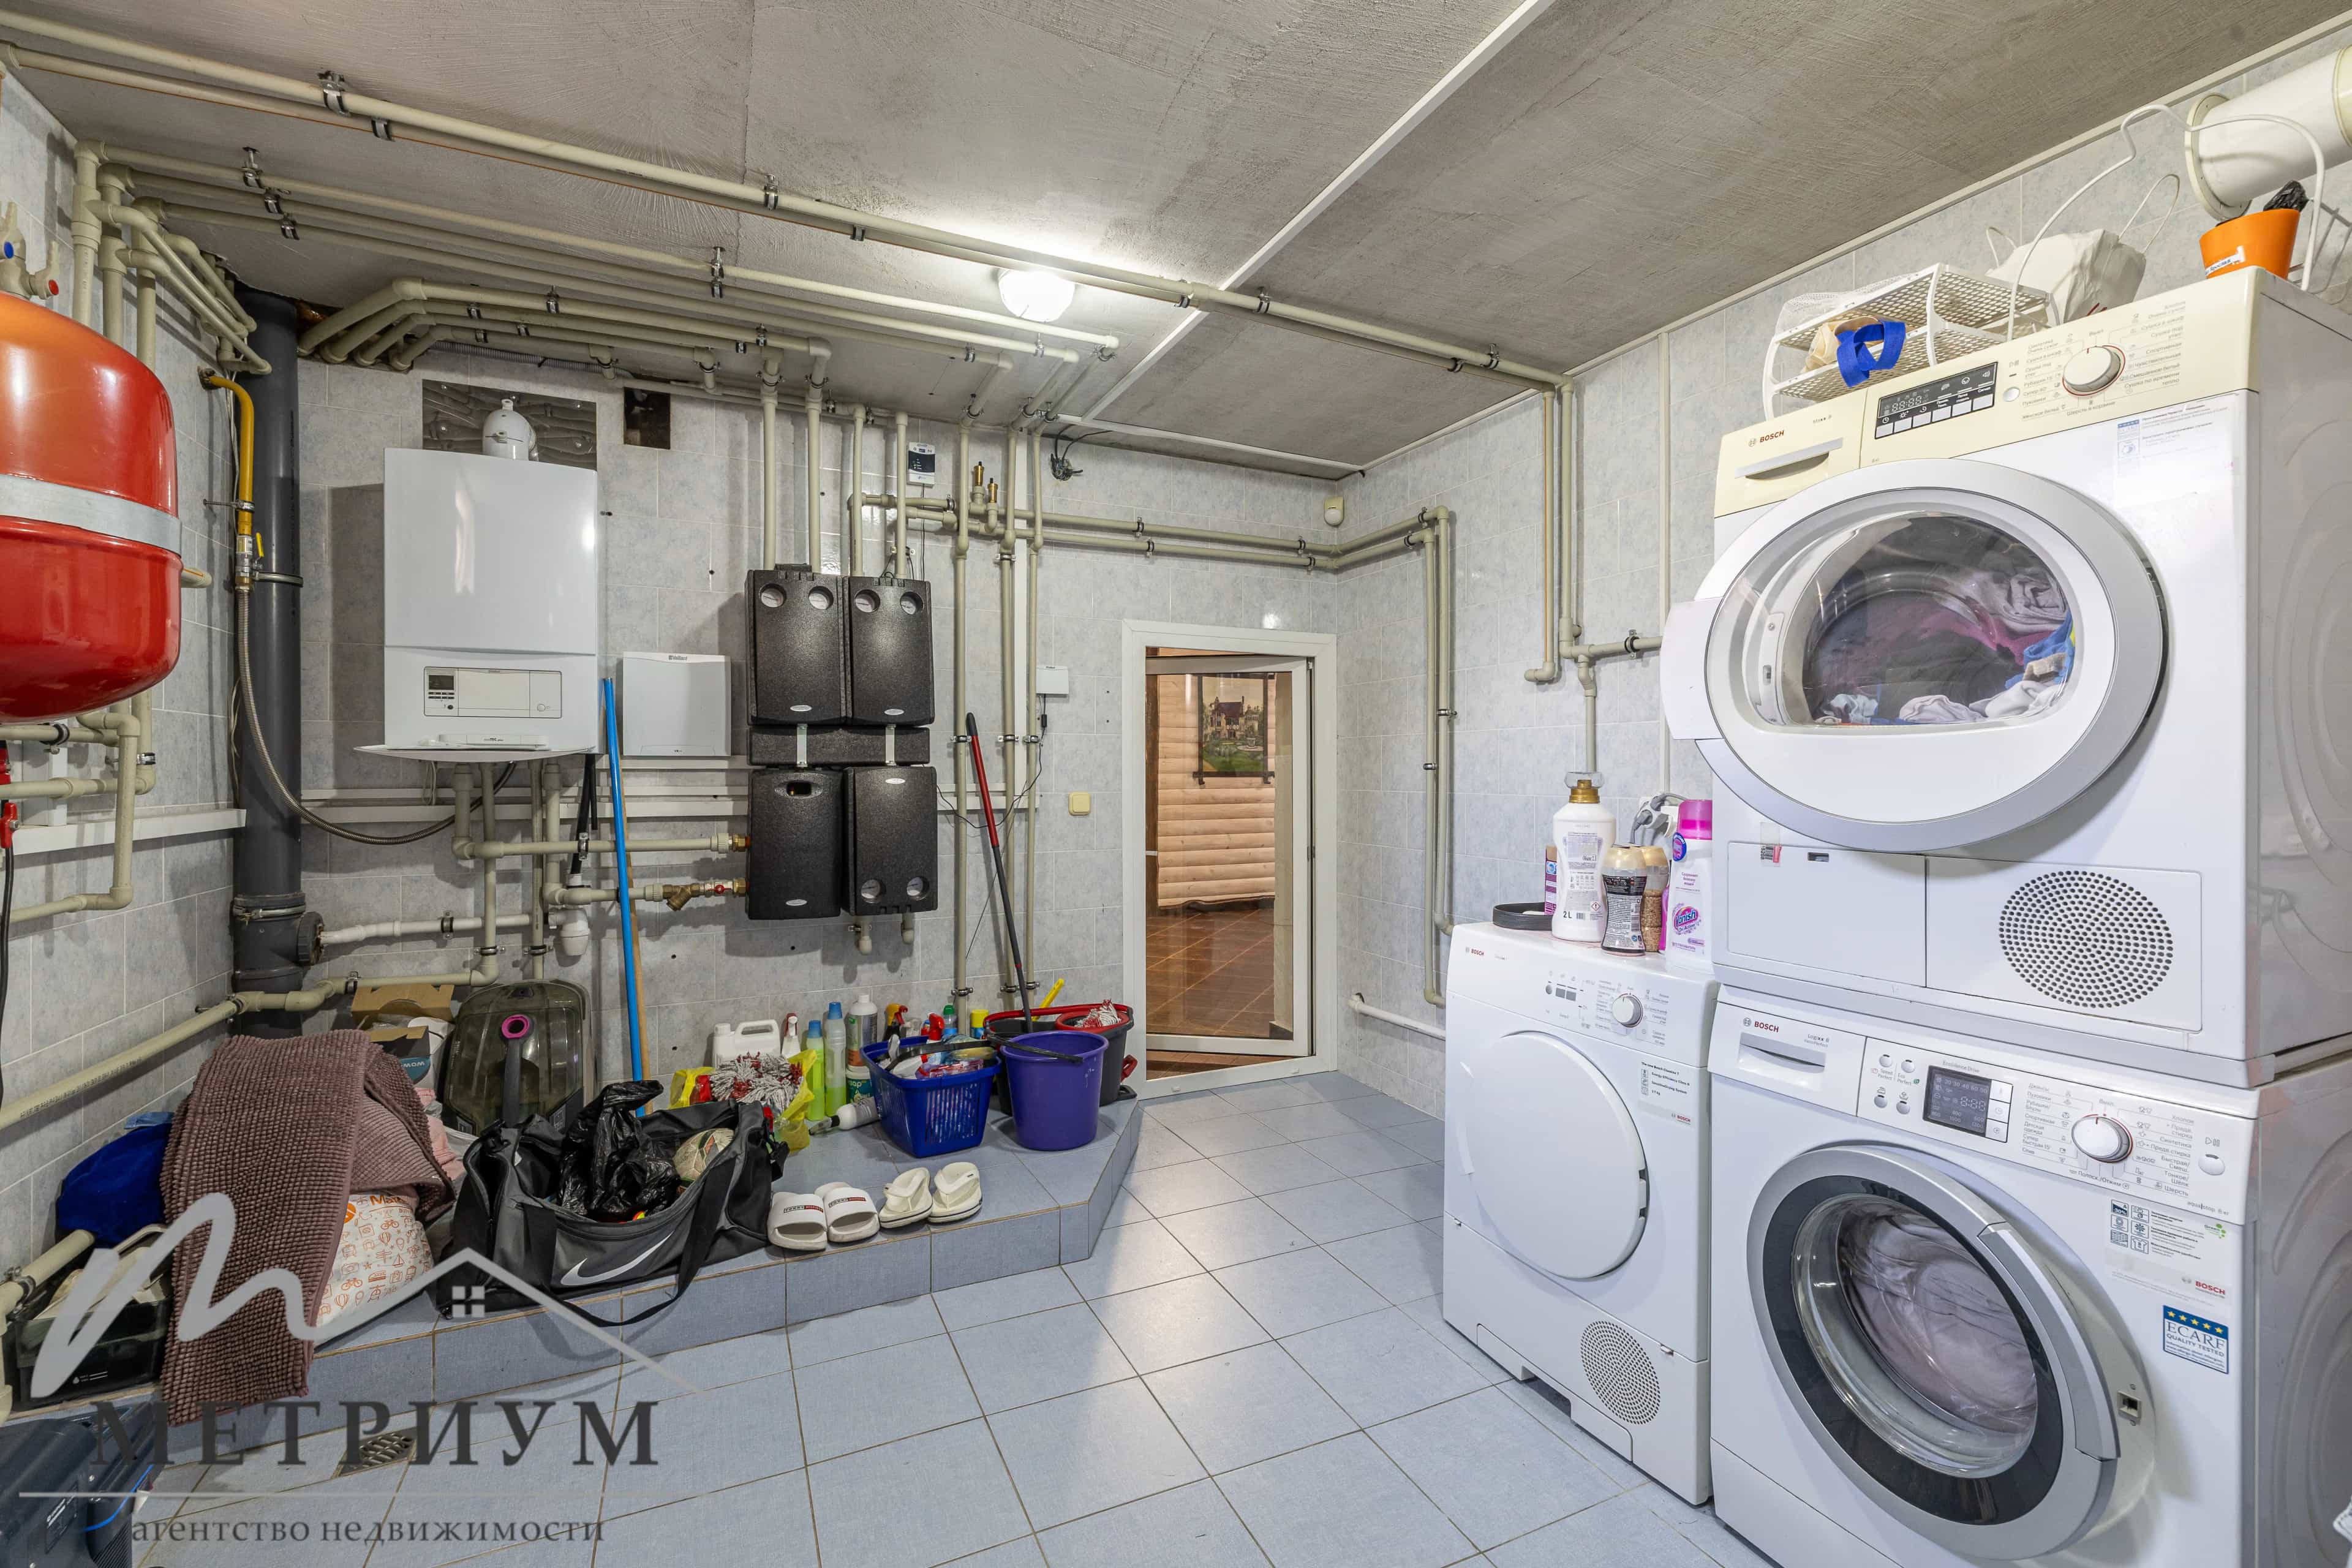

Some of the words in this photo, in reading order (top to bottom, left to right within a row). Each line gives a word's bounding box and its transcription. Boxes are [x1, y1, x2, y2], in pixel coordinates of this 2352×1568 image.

[1759, 430, 1784, 443] BOSCH
[1676, 909, 1696, 927] Vanish
[1754, 1021, 1779, 1033] BOSCH
[2025, 1114, 2055, 1125] Спортивная
[2024, 1121, 2045, 1131] Детская
[2022, 1134, 2039, 1142] Супер
[2171, 1131, 2193, 1140] стирка
[2160, 1137, 2193, 1149] Синтетика
[2161, 1155, 2190, 1167] Быстрая/
[2165, 1170, 2190, 1182] Тонкое/
[2164, 1185, 2189, 1196] Шерсть
[2195, 1281, 2225, 1295] BOSCH
[2166, 1321, 2225, 1350] ECARF
[2166, 1333, 2196, 1347] QUALITY
[2198, 1344, 2225, 1357] TESTED
